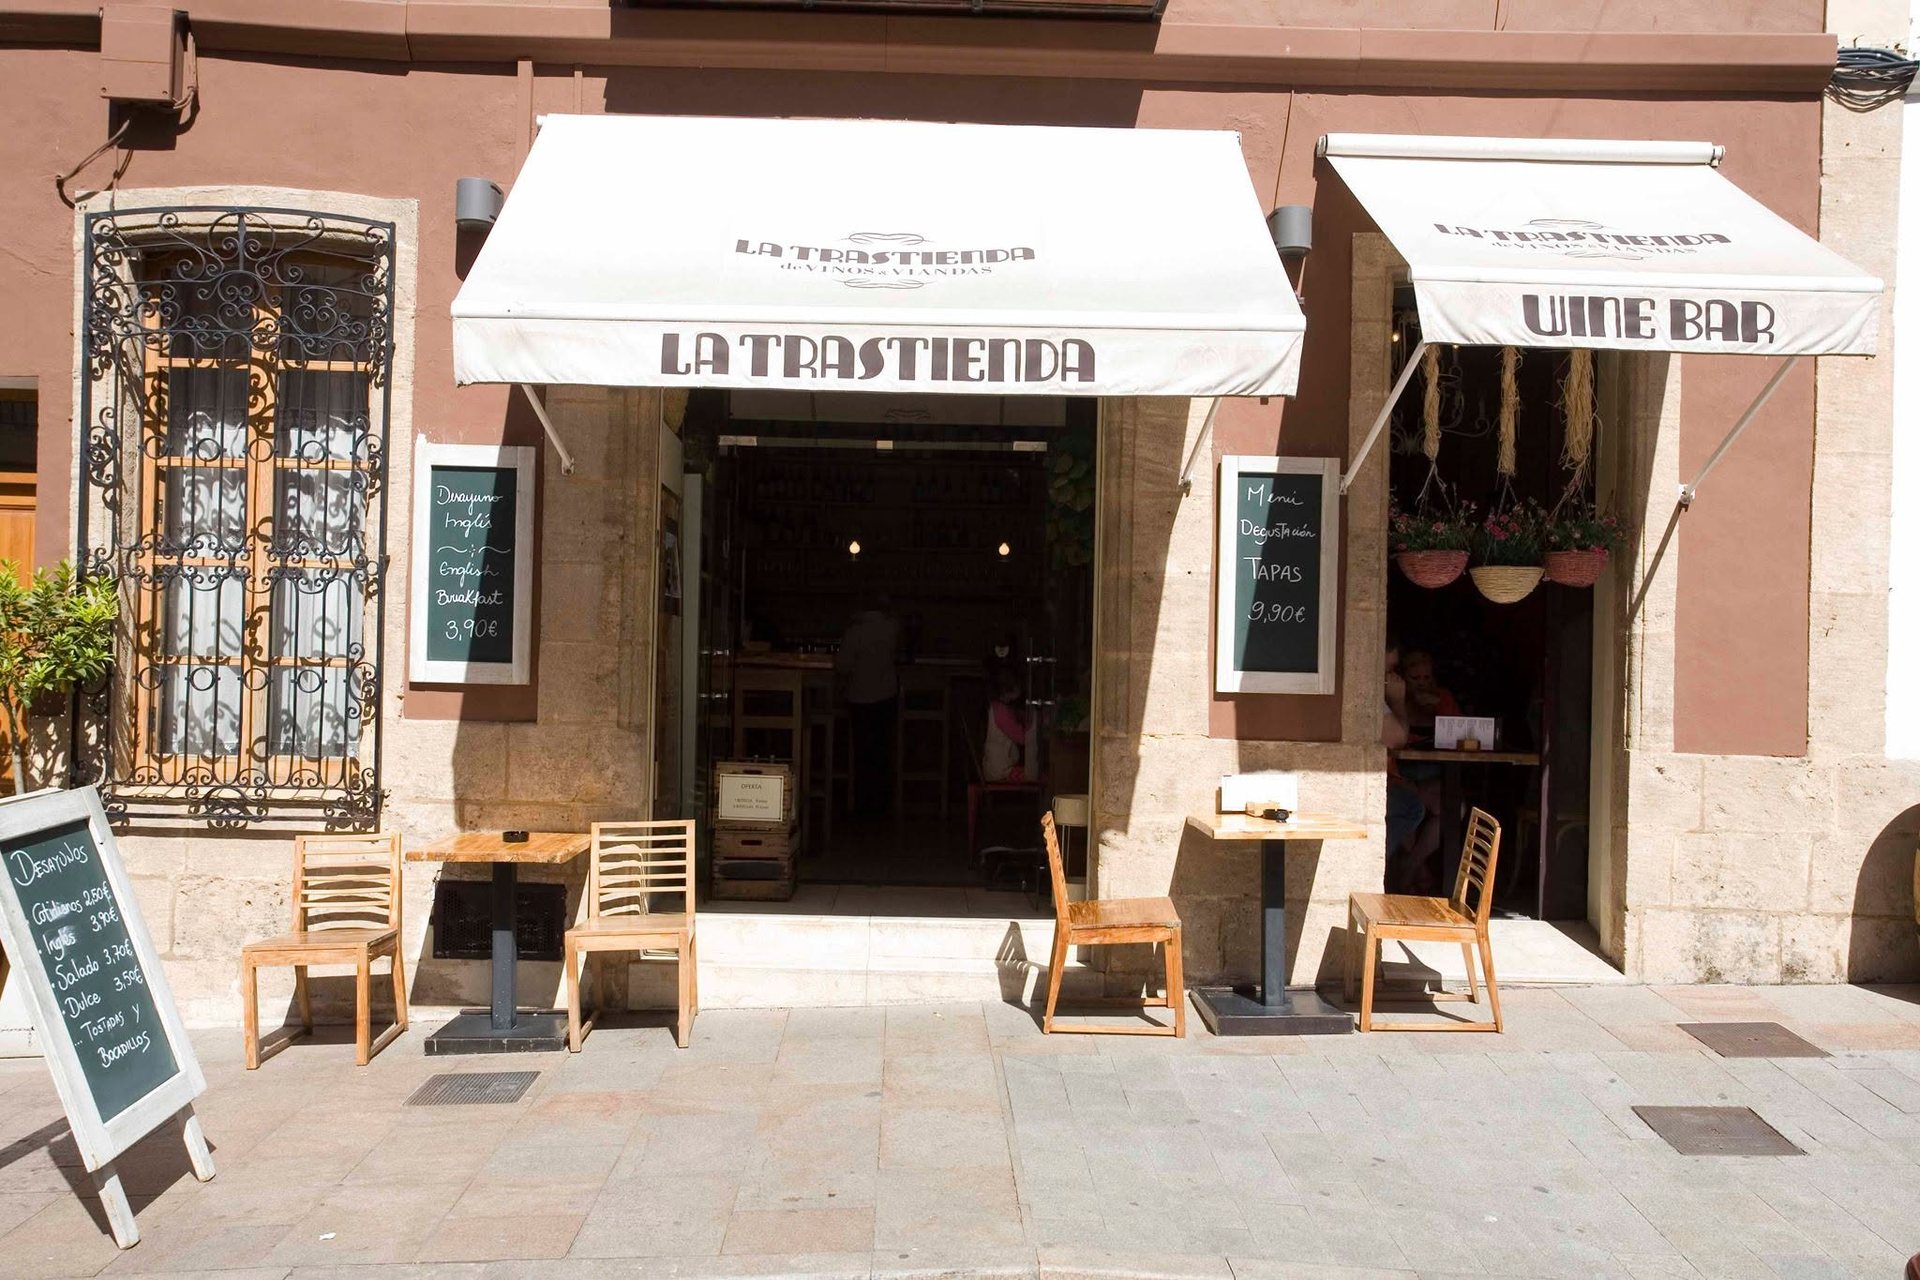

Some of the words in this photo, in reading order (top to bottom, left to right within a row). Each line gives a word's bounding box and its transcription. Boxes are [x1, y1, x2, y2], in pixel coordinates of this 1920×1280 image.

[1434, 223, 1483, 239] LA
[1484, 228, 1733, 246] TRASTIENDA
[735, 239, 783, 258] LA
[790, 245, 1035, 266] TRASTIENDA
[892, 266, 992, 276] VIANDAS
[1522, 294, 1656, 340] WINE
[1669, 298, 1775, 343] BAR
[661, 332, 730, 375] LA
[739, 334, 1096, 383] TRASTIENDA
[436, 485, 503, 515] Desayuno
[1247, 483, 1304, 507] Menú
[439, 561, 499, 588] English
[1243, 556, 1303, 583] TAPAS
[1247, 601, 1306, 623] 9,90€
[445, 618, 498, 641] 3,90€
[83, 881, 112, 907] 2,50€
[90, 906, 119, 932] 3,90€
[55, 954, 99, 990] Salado
[103, 938, 133, 965] 3,70€
[64, 991, 101, 1019] Dulce
[113, 965, 143, 991] 3,50€
